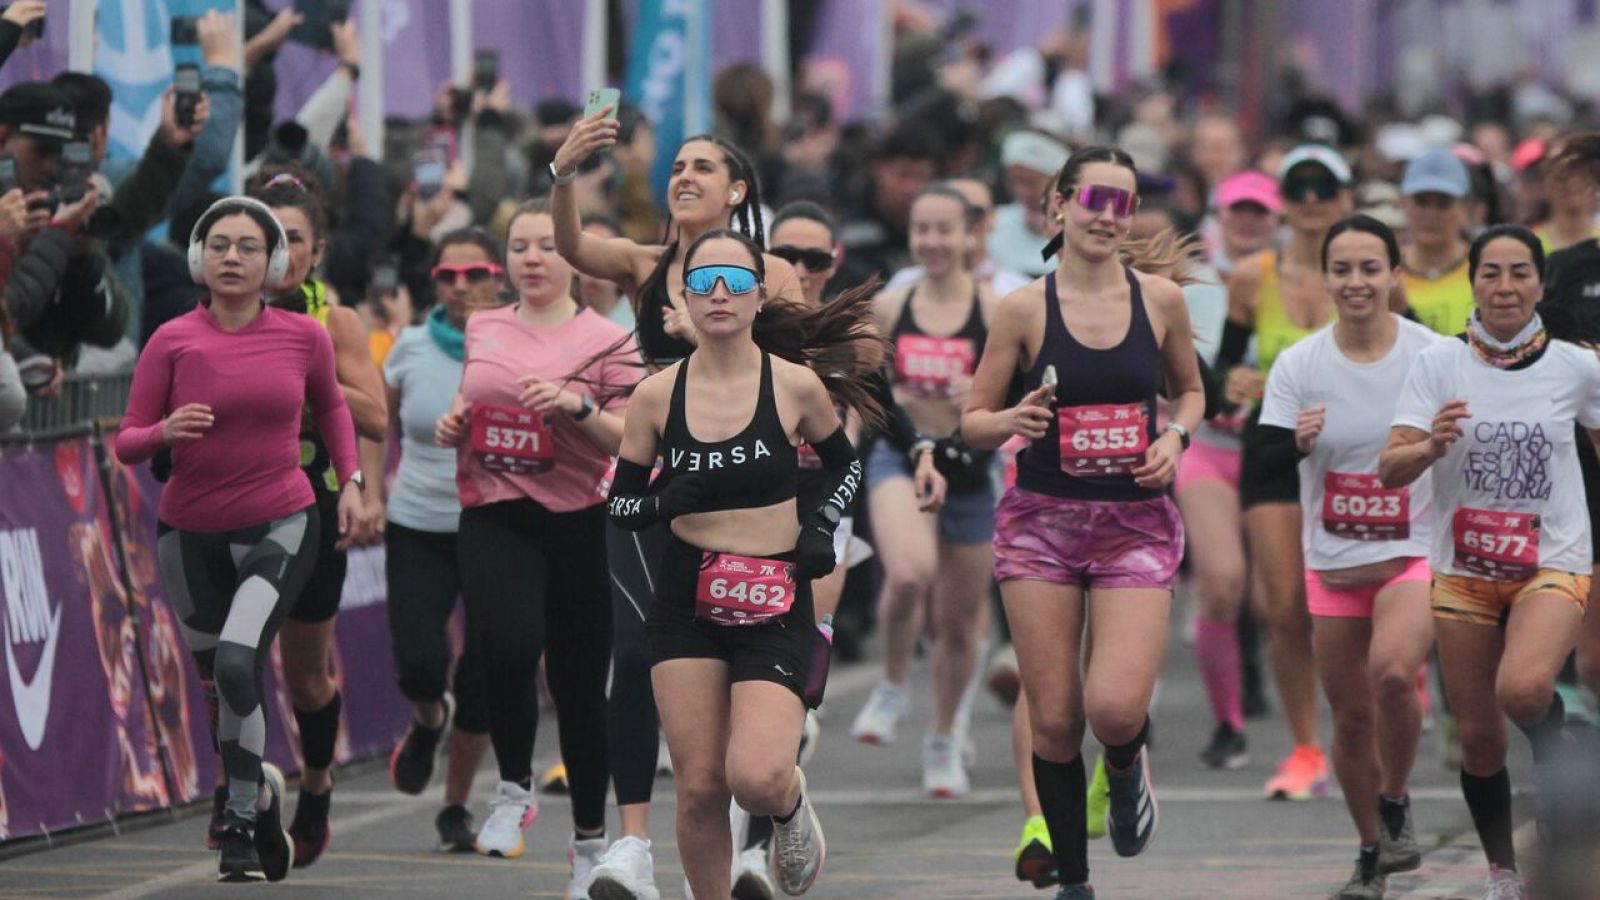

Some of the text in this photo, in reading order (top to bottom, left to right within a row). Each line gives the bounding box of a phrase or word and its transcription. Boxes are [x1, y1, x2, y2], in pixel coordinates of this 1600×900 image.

[485, 426, 540, 453] 5371
[1072, 425, 1139, 451] 6353
[1474, 421, 1546, 443] CADA
[1464, 469, 1553, 501] VICTORIA
[1332, 494, 1401, 517] 6023
[1464, 530, 1528, 558] 6577
[760, 565, 776, 576] 7K
[709, 578, 785, 608] 6462
